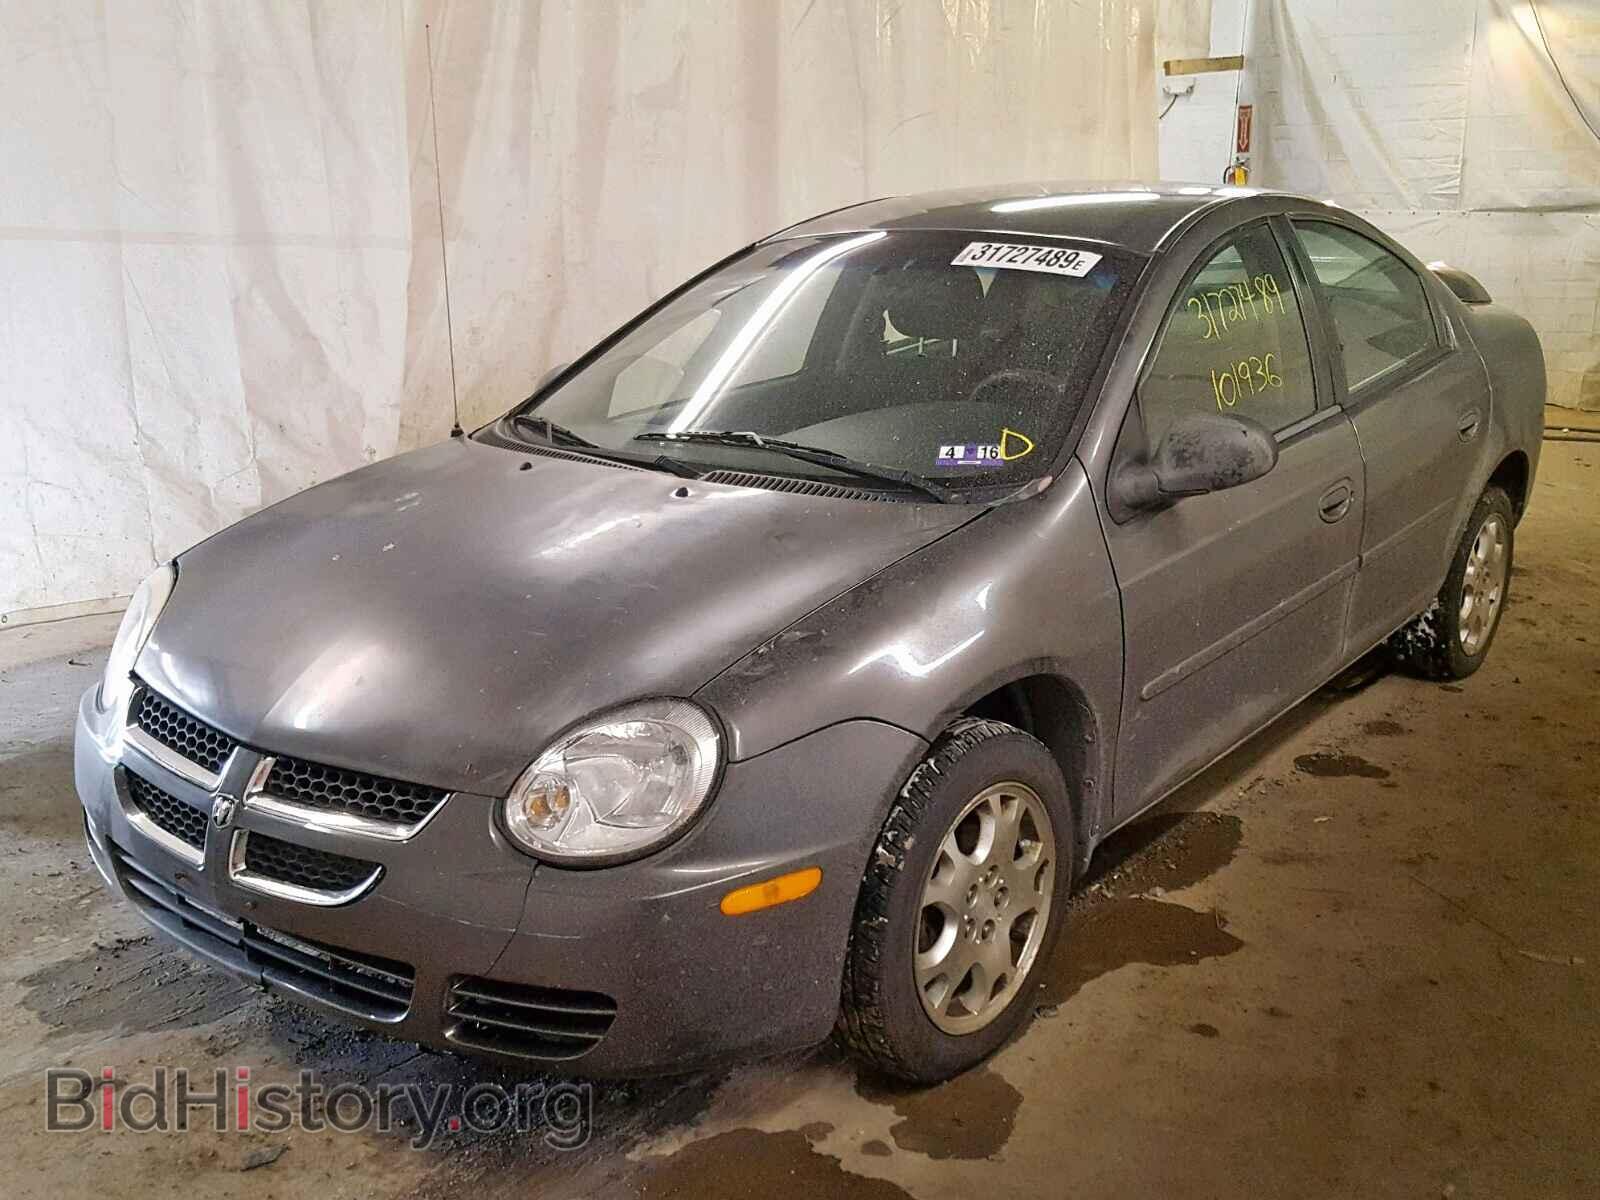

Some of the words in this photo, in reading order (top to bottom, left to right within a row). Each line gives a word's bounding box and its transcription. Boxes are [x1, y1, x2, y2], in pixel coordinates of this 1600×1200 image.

[1187, 273, 1286, 340] 31727489
[1210, 352, 1283, 412] 101936
[945, 446, 956, 459] 4
[980, 446, 999, 459] 16
